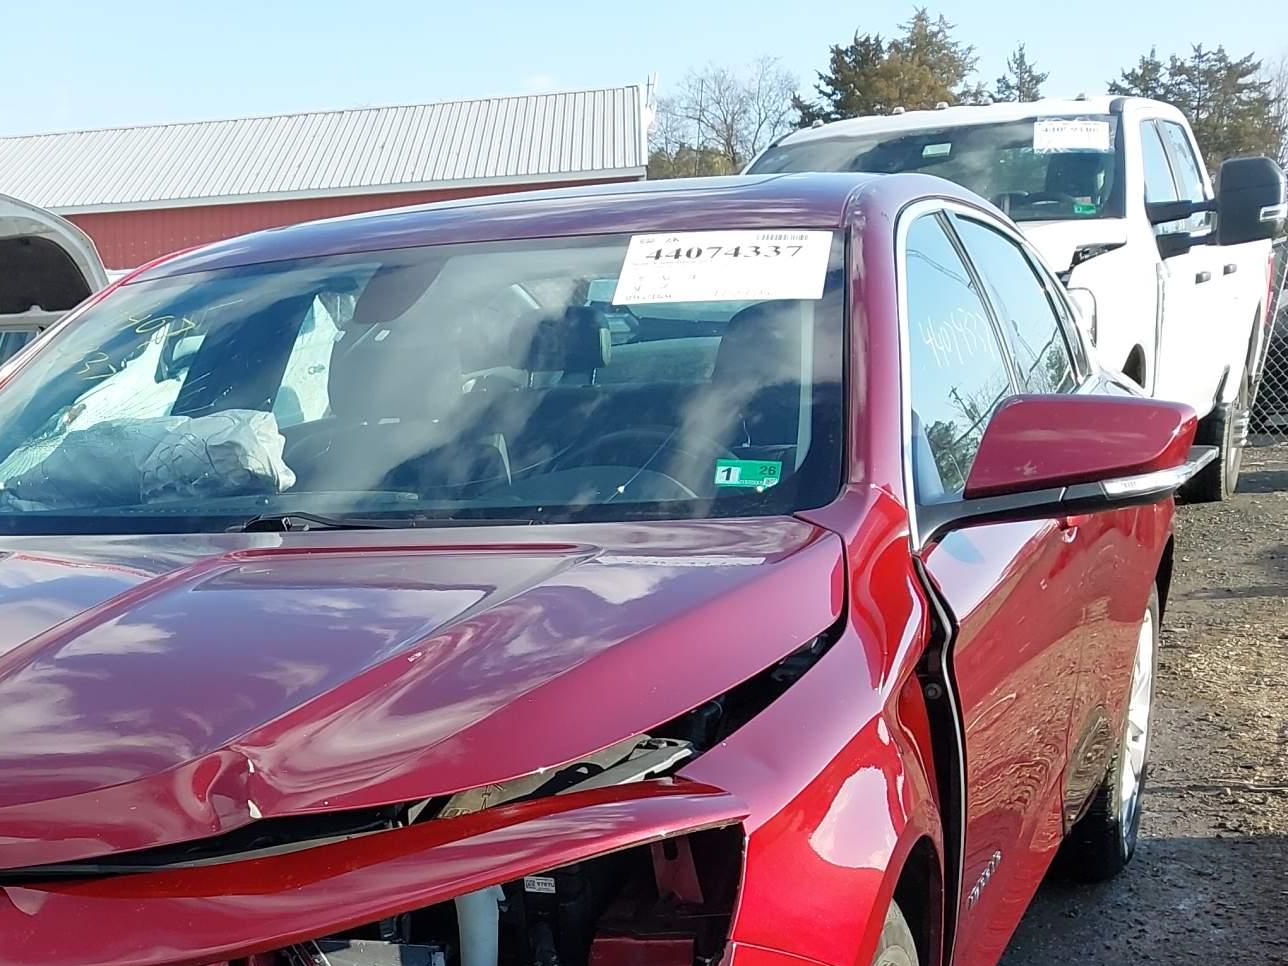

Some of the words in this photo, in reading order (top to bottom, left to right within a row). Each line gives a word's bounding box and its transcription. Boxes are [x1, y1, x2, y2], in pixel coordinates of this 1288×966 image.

[645, 245, 805, 261] 44074337
[721, 467, 732, 481] 1
[759, 465, 776, 476] 26
